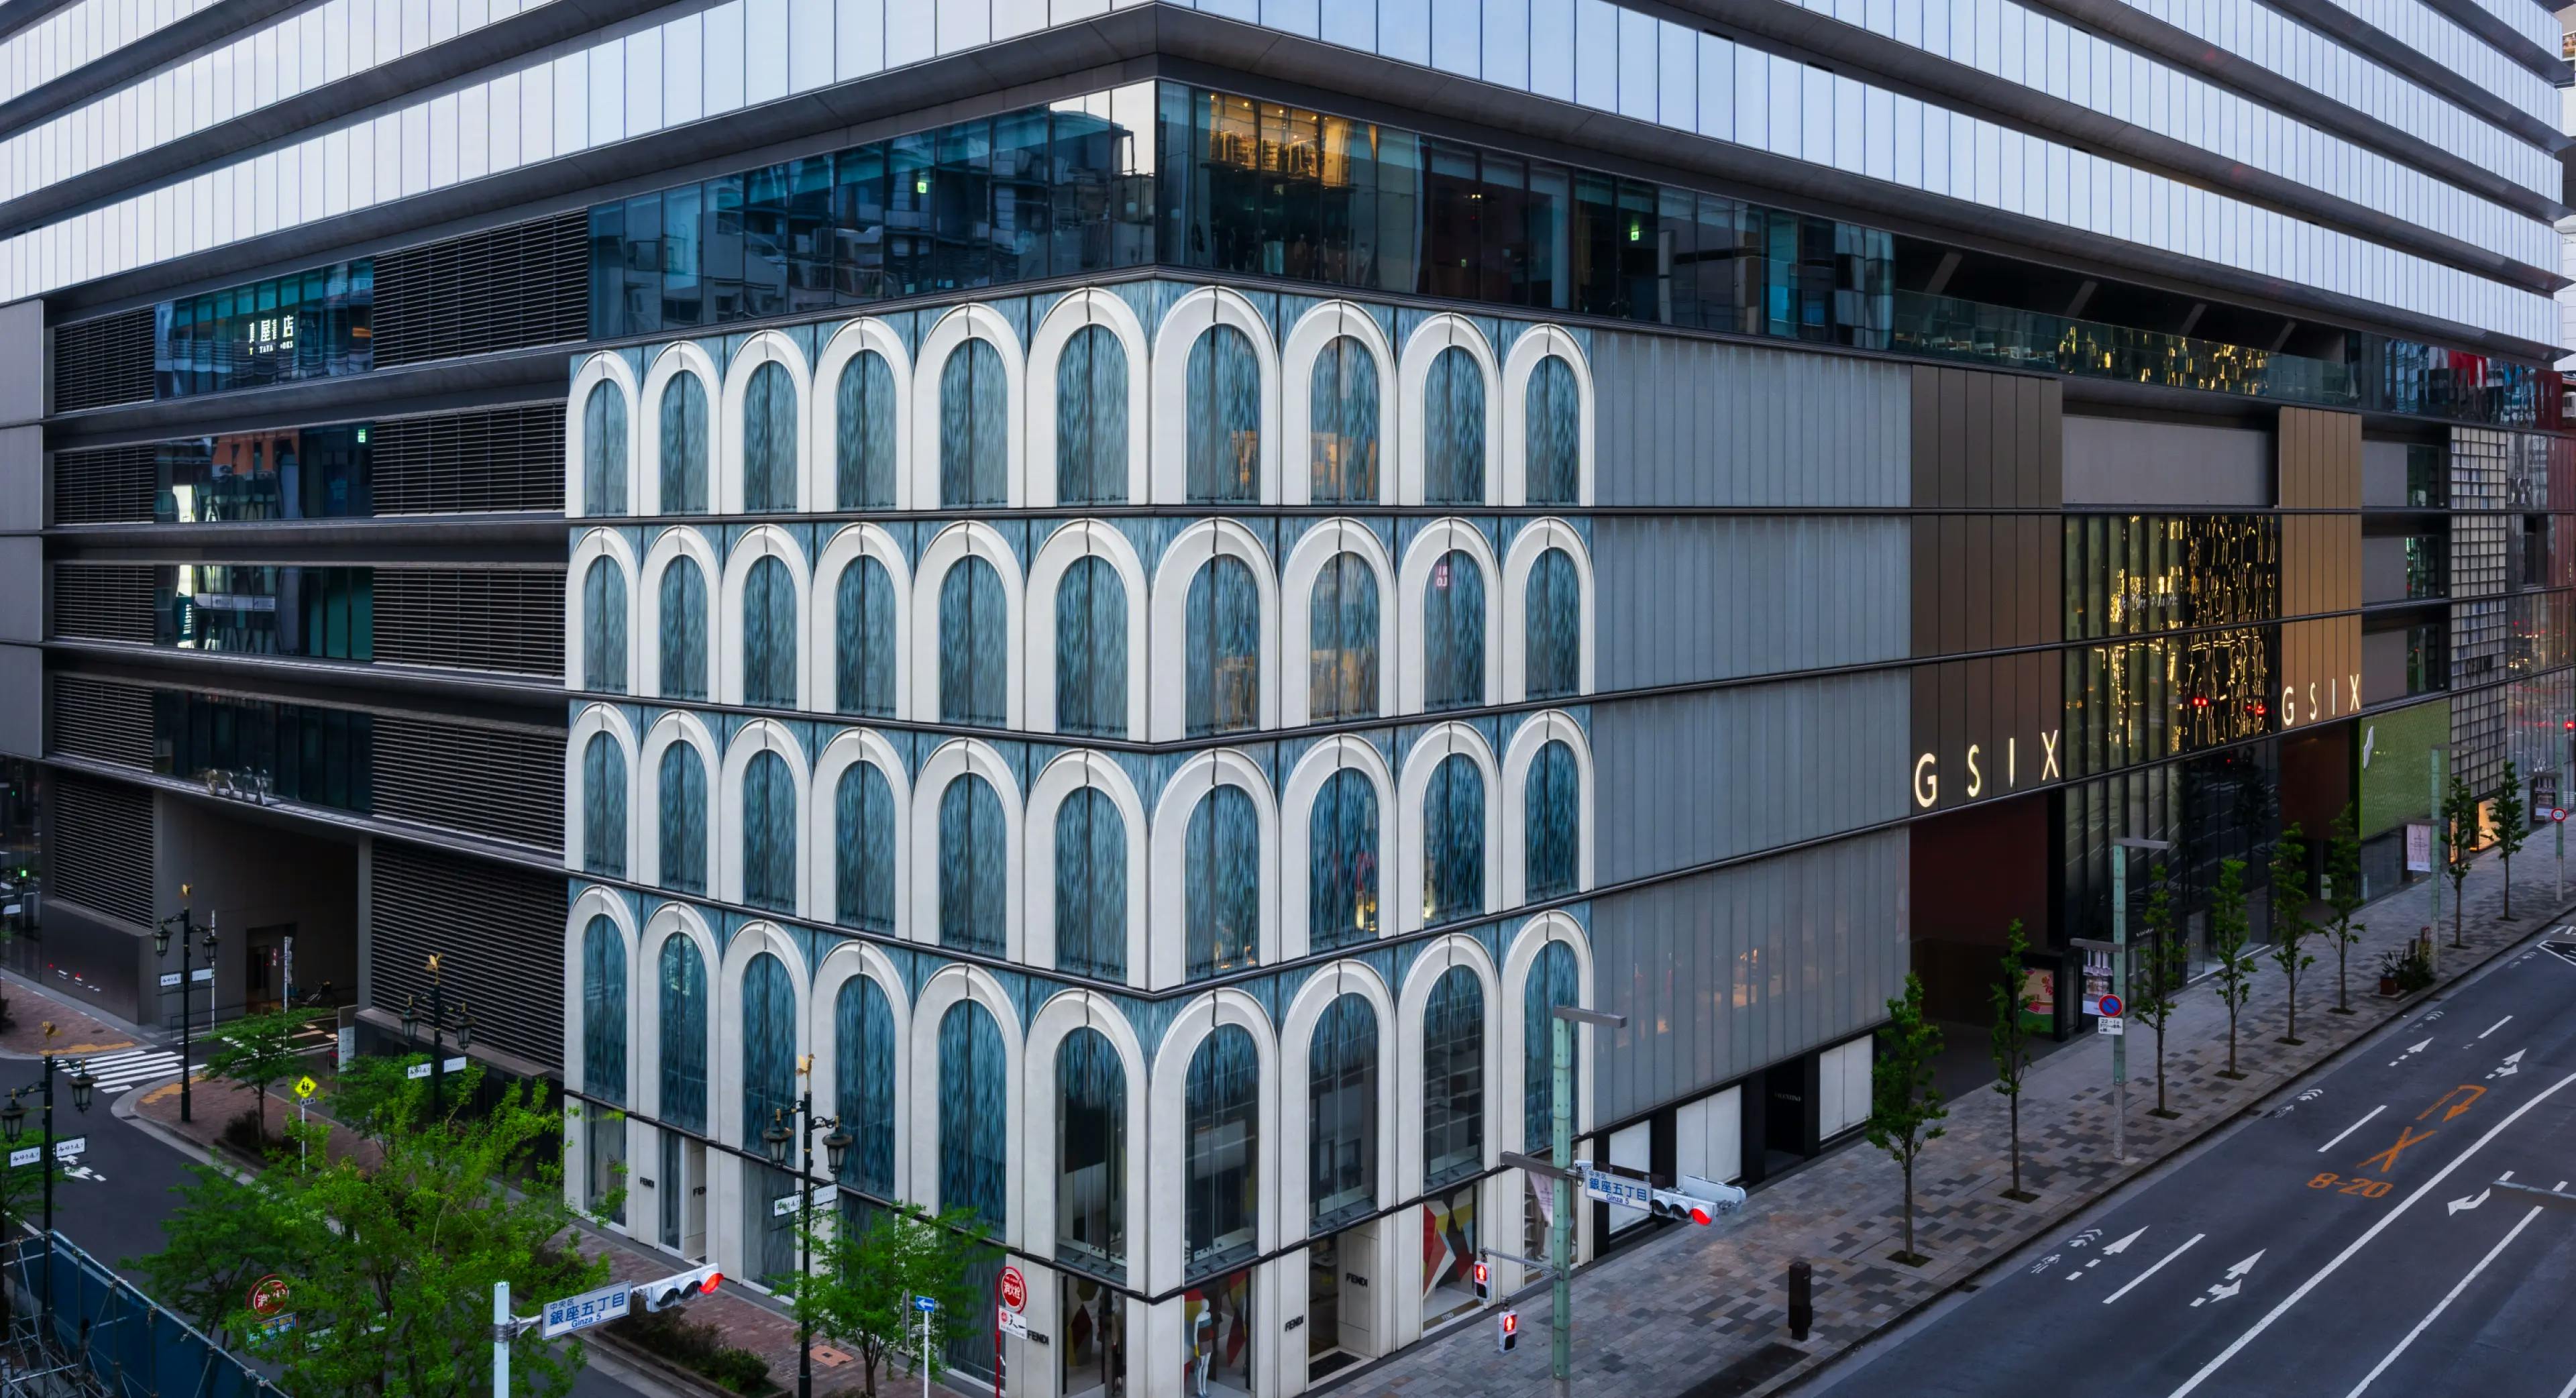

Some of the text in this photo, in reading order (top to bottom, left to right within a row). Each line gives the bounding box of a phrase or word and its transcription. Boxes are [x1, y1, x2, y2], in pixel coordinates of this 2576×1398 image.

[1589, 1177, 1647, 1201] 銀座五丁目
[2306, 1173, 2394, 1198] 8-20
[1606, 1193, 1623, 1203] Ginza
[1346, 1273, 1368, 1288] FENDI
[549, 1297, 575, 1310] 中央区
[549, 1292, 625, 1326] 銀座五丁目
[571, 1315, 593, 1328] Ginza
[1284, 1314, 1304, 1332] FENDI
[1026, 1329, 1050, 1346] FENDI
